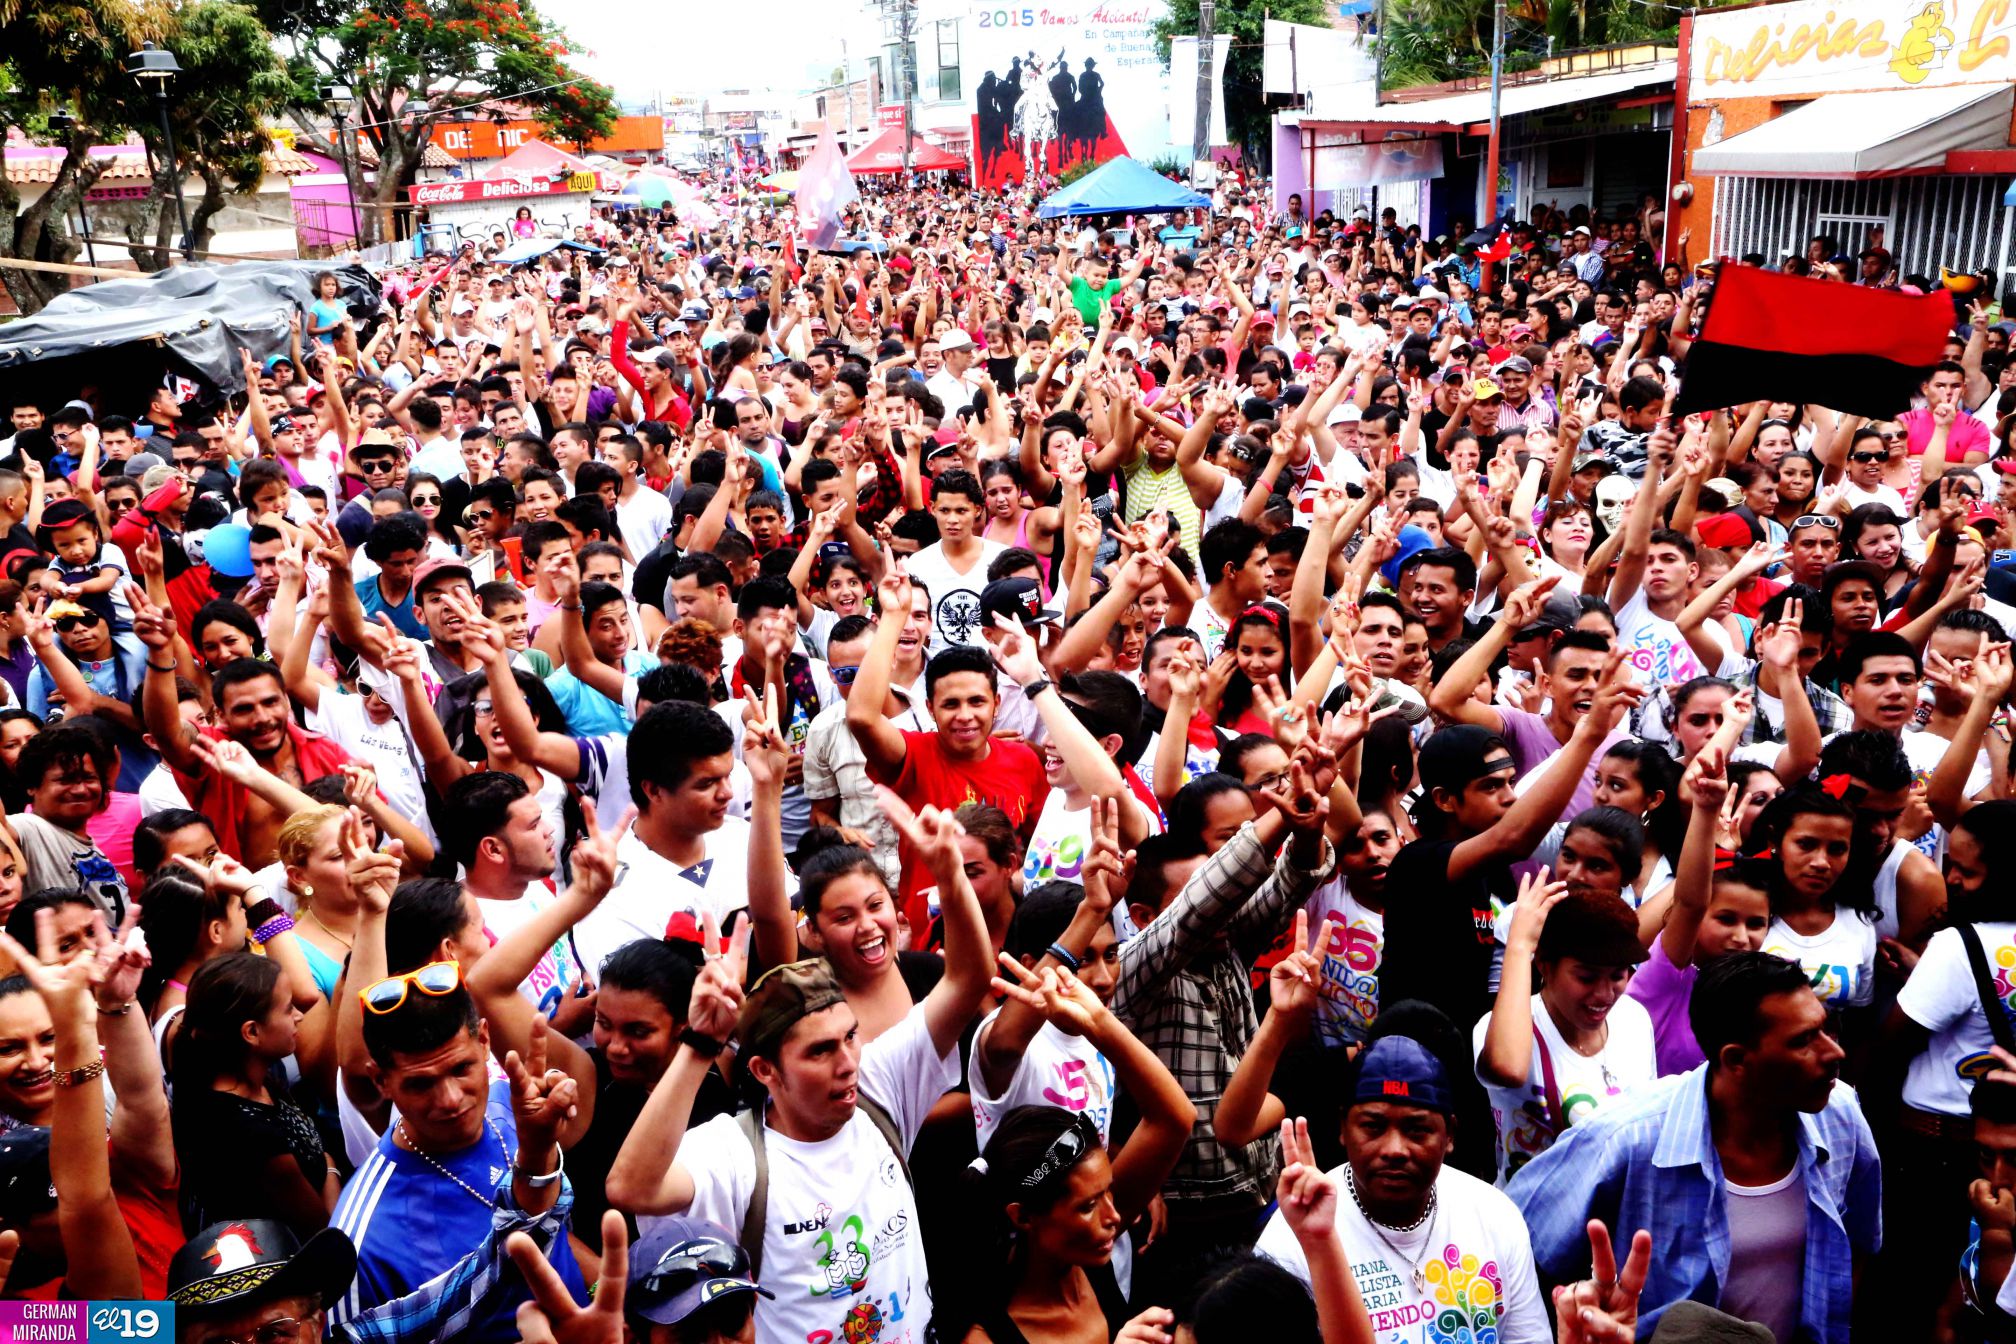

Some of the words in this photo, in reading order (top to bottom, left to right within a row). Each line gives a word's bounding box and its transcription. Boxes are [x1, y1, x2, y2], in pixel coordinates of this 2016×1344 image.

[979, 9, 1034, 28] 2015
[1040, 8, 1079, 25] Vamos
[1085, 30, 1097, 39] En
[1104, 43, 1117, 53] de
[1120, 42, 1151, 52] Buena
[1704, 10, 1889, 86] Delicias
[445, 130, 473, 150] DE
[482, 179, 550, 197] Deliciosa
[1383, 1080, 1409, 1097] NBA
[1350, 1260, 1392, 1278] IANA,
